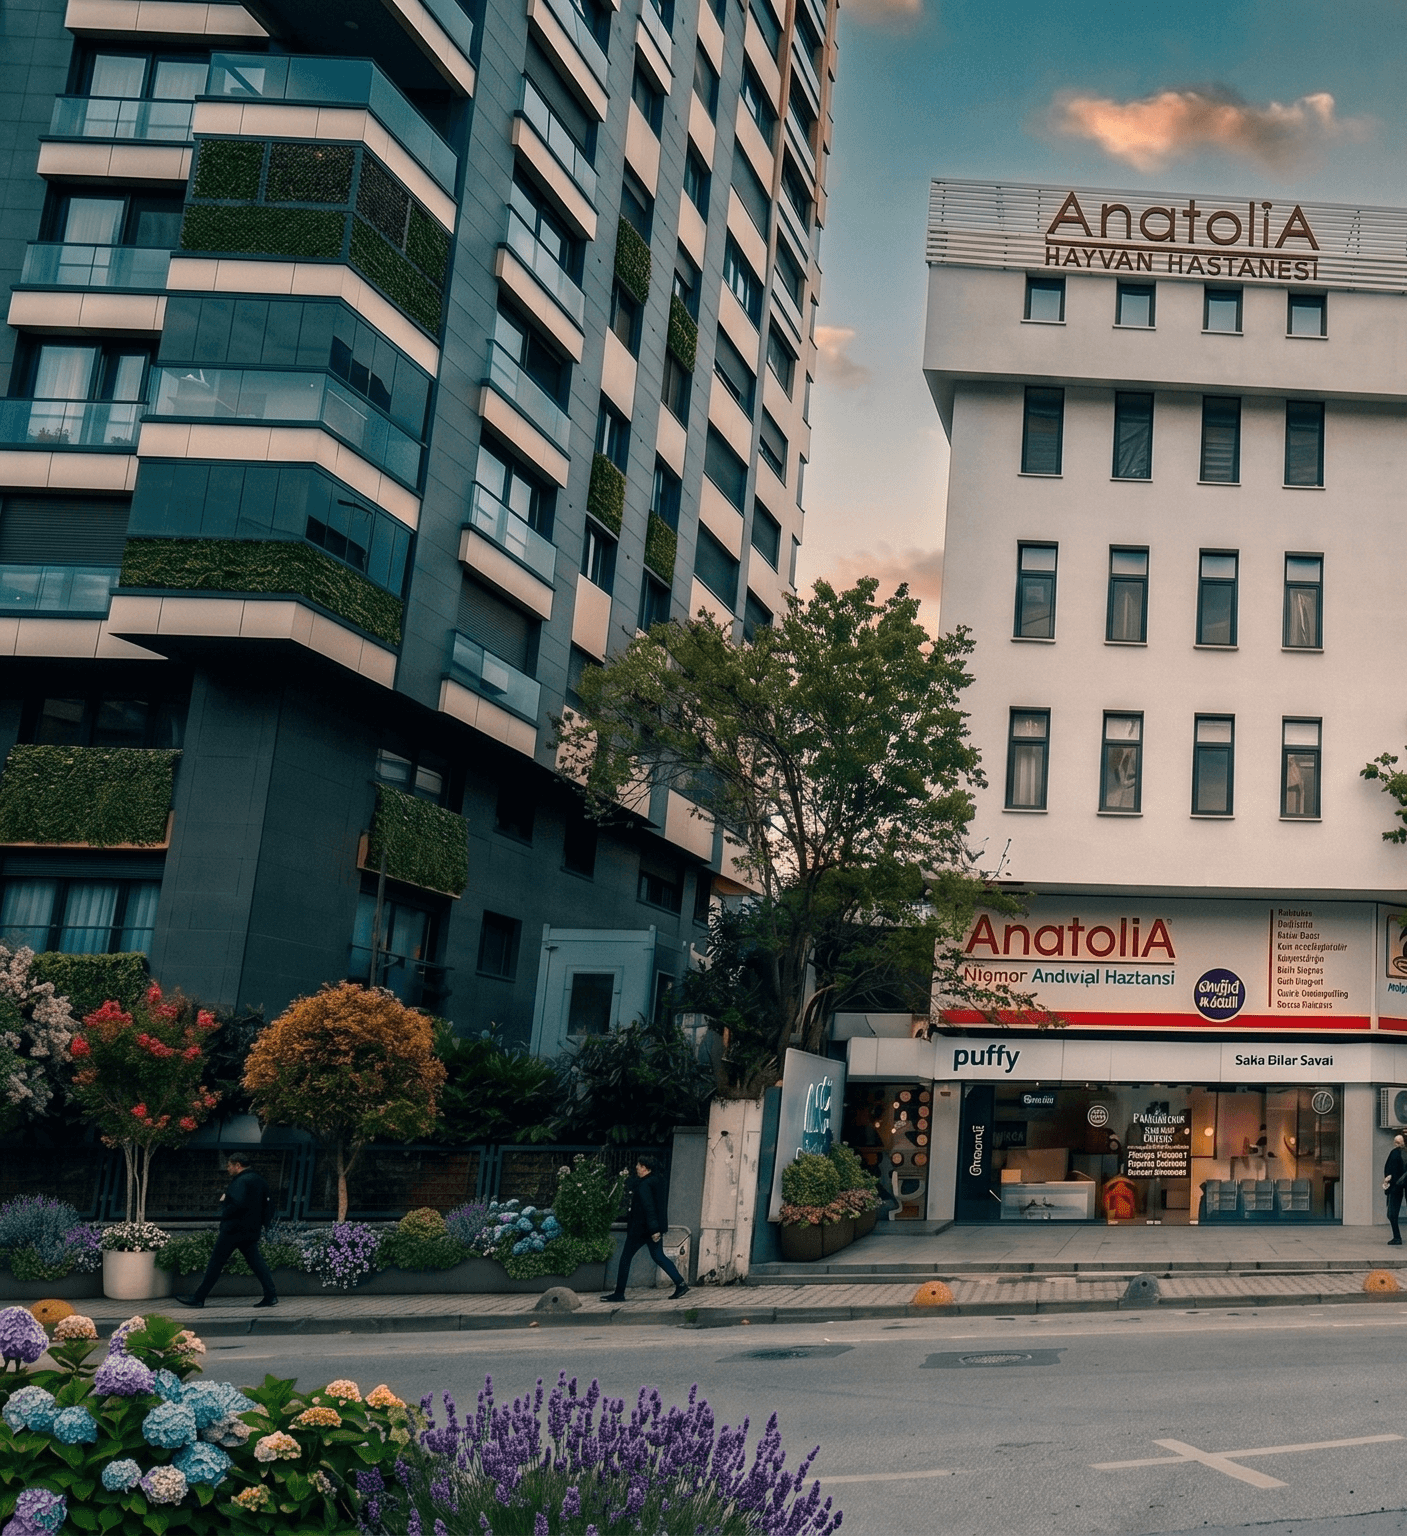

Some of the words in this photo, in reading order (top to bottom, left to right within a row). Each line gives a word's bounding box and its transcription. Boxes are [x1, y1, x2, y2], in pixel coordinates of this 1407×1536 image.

[1045, 246, 1153, 272] HAYVAN
[1105, 969, 1175, 985] Haztansi
[953, 1044, 1021, 1074] puffy
[1235, 1055, 1265, 1066] Saka
[1268, 1055, 1298, 1066] Bilar
[1300, 1055, 1334, 1066] Savai
